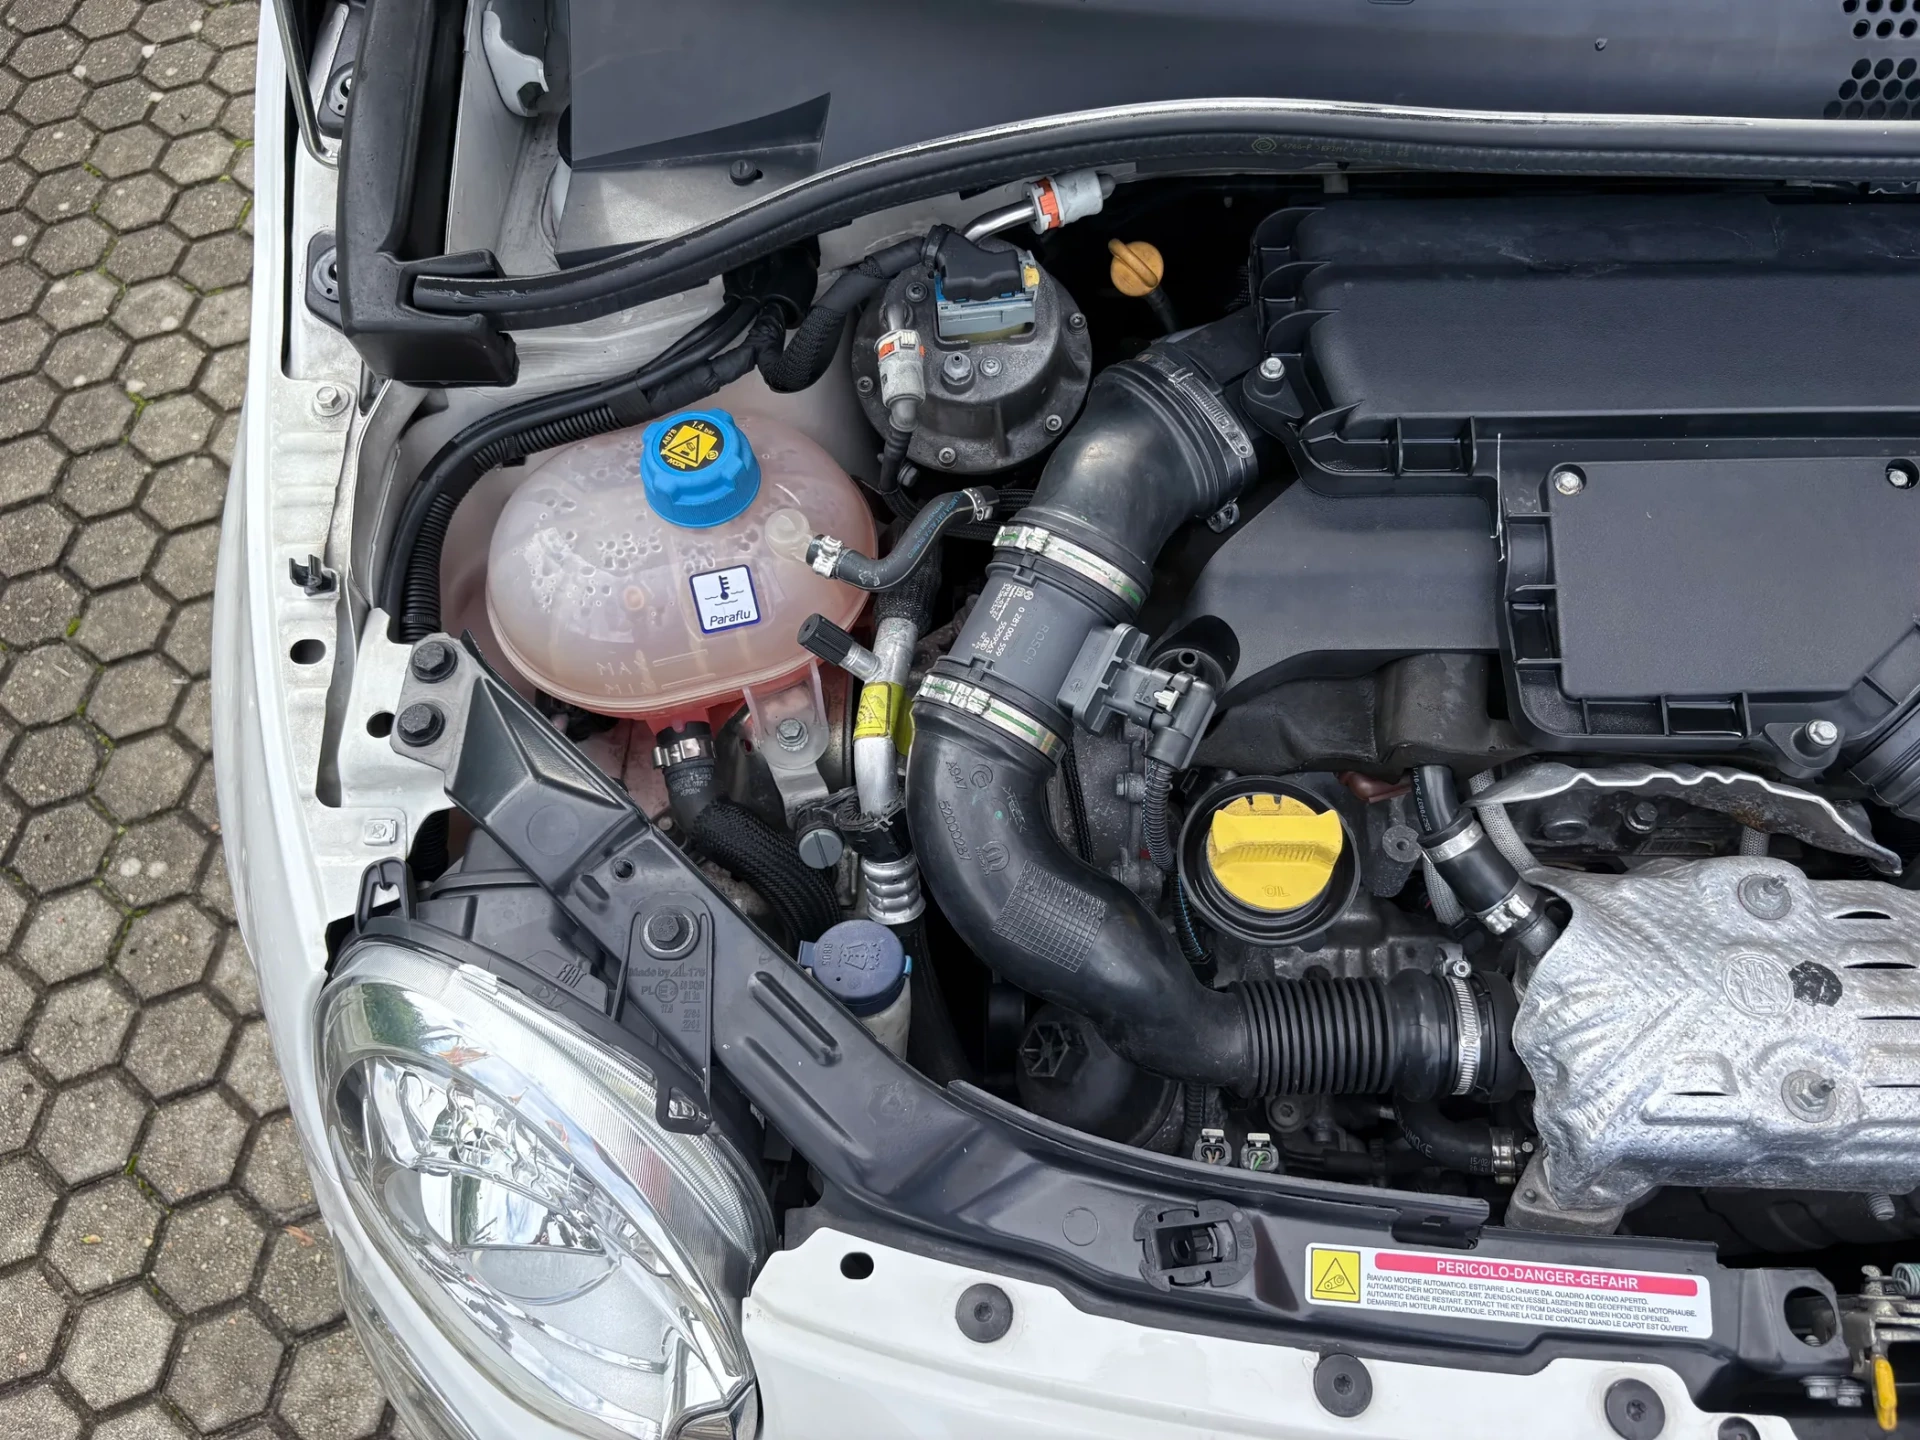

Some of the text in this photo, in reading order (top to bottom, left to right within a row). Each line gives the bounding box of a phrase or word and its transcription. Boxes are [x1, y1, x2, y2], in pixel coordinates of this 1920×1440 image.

[709, 610, 751, 627] Paraflu
[1002, 627, 1014, 641] 006
[1023, 624, 1051, 665] BOSCH
[995, 642, 1007, 657] 559
[1264, 884, 1290, 898] OIL
[556, 962, 588, 989] FIAT
[1366, 1283, 1422, 1294] AUTOMATISCHER
[1436, 1260, 1639, 1290] PERICOLO-DANGER-GEFAHR
[1394, 1276, 1422, 1286] MOTORE
[1515, 1287, 1540, 1296] CHIAVE
[1555, 1290, 1584, 1300] QUADRO
[1591, 1294, 1619, 1303] COFANO
[1366, 1291, 1404, 1300] AUTOMATIC
[1405, 1294, 1430, 1303] ENGINE
[1465, 1299, 1494, 1308] EXTRACT
[1526, 1304, 1546, 1312] FROM
[1547, 1306, 1588, 1316] DASHBOARD
[1590, 1309, 1610, 1318] WHEN
[1612, 1311, 1631, 1319] HOOD
[1366, 1298, 1408, 1309] DEMARREUR
[1409, 1302, 1437, 1311] MOTEUR
[1488, 1309, 1520, 1318] EXTRAIRE
[1556, 1314, 1586, 1324] CONTACT
[1588, 1317, 1611, 1326] QUAND
[1622, 1320, 1645, 1329] CAPOT
